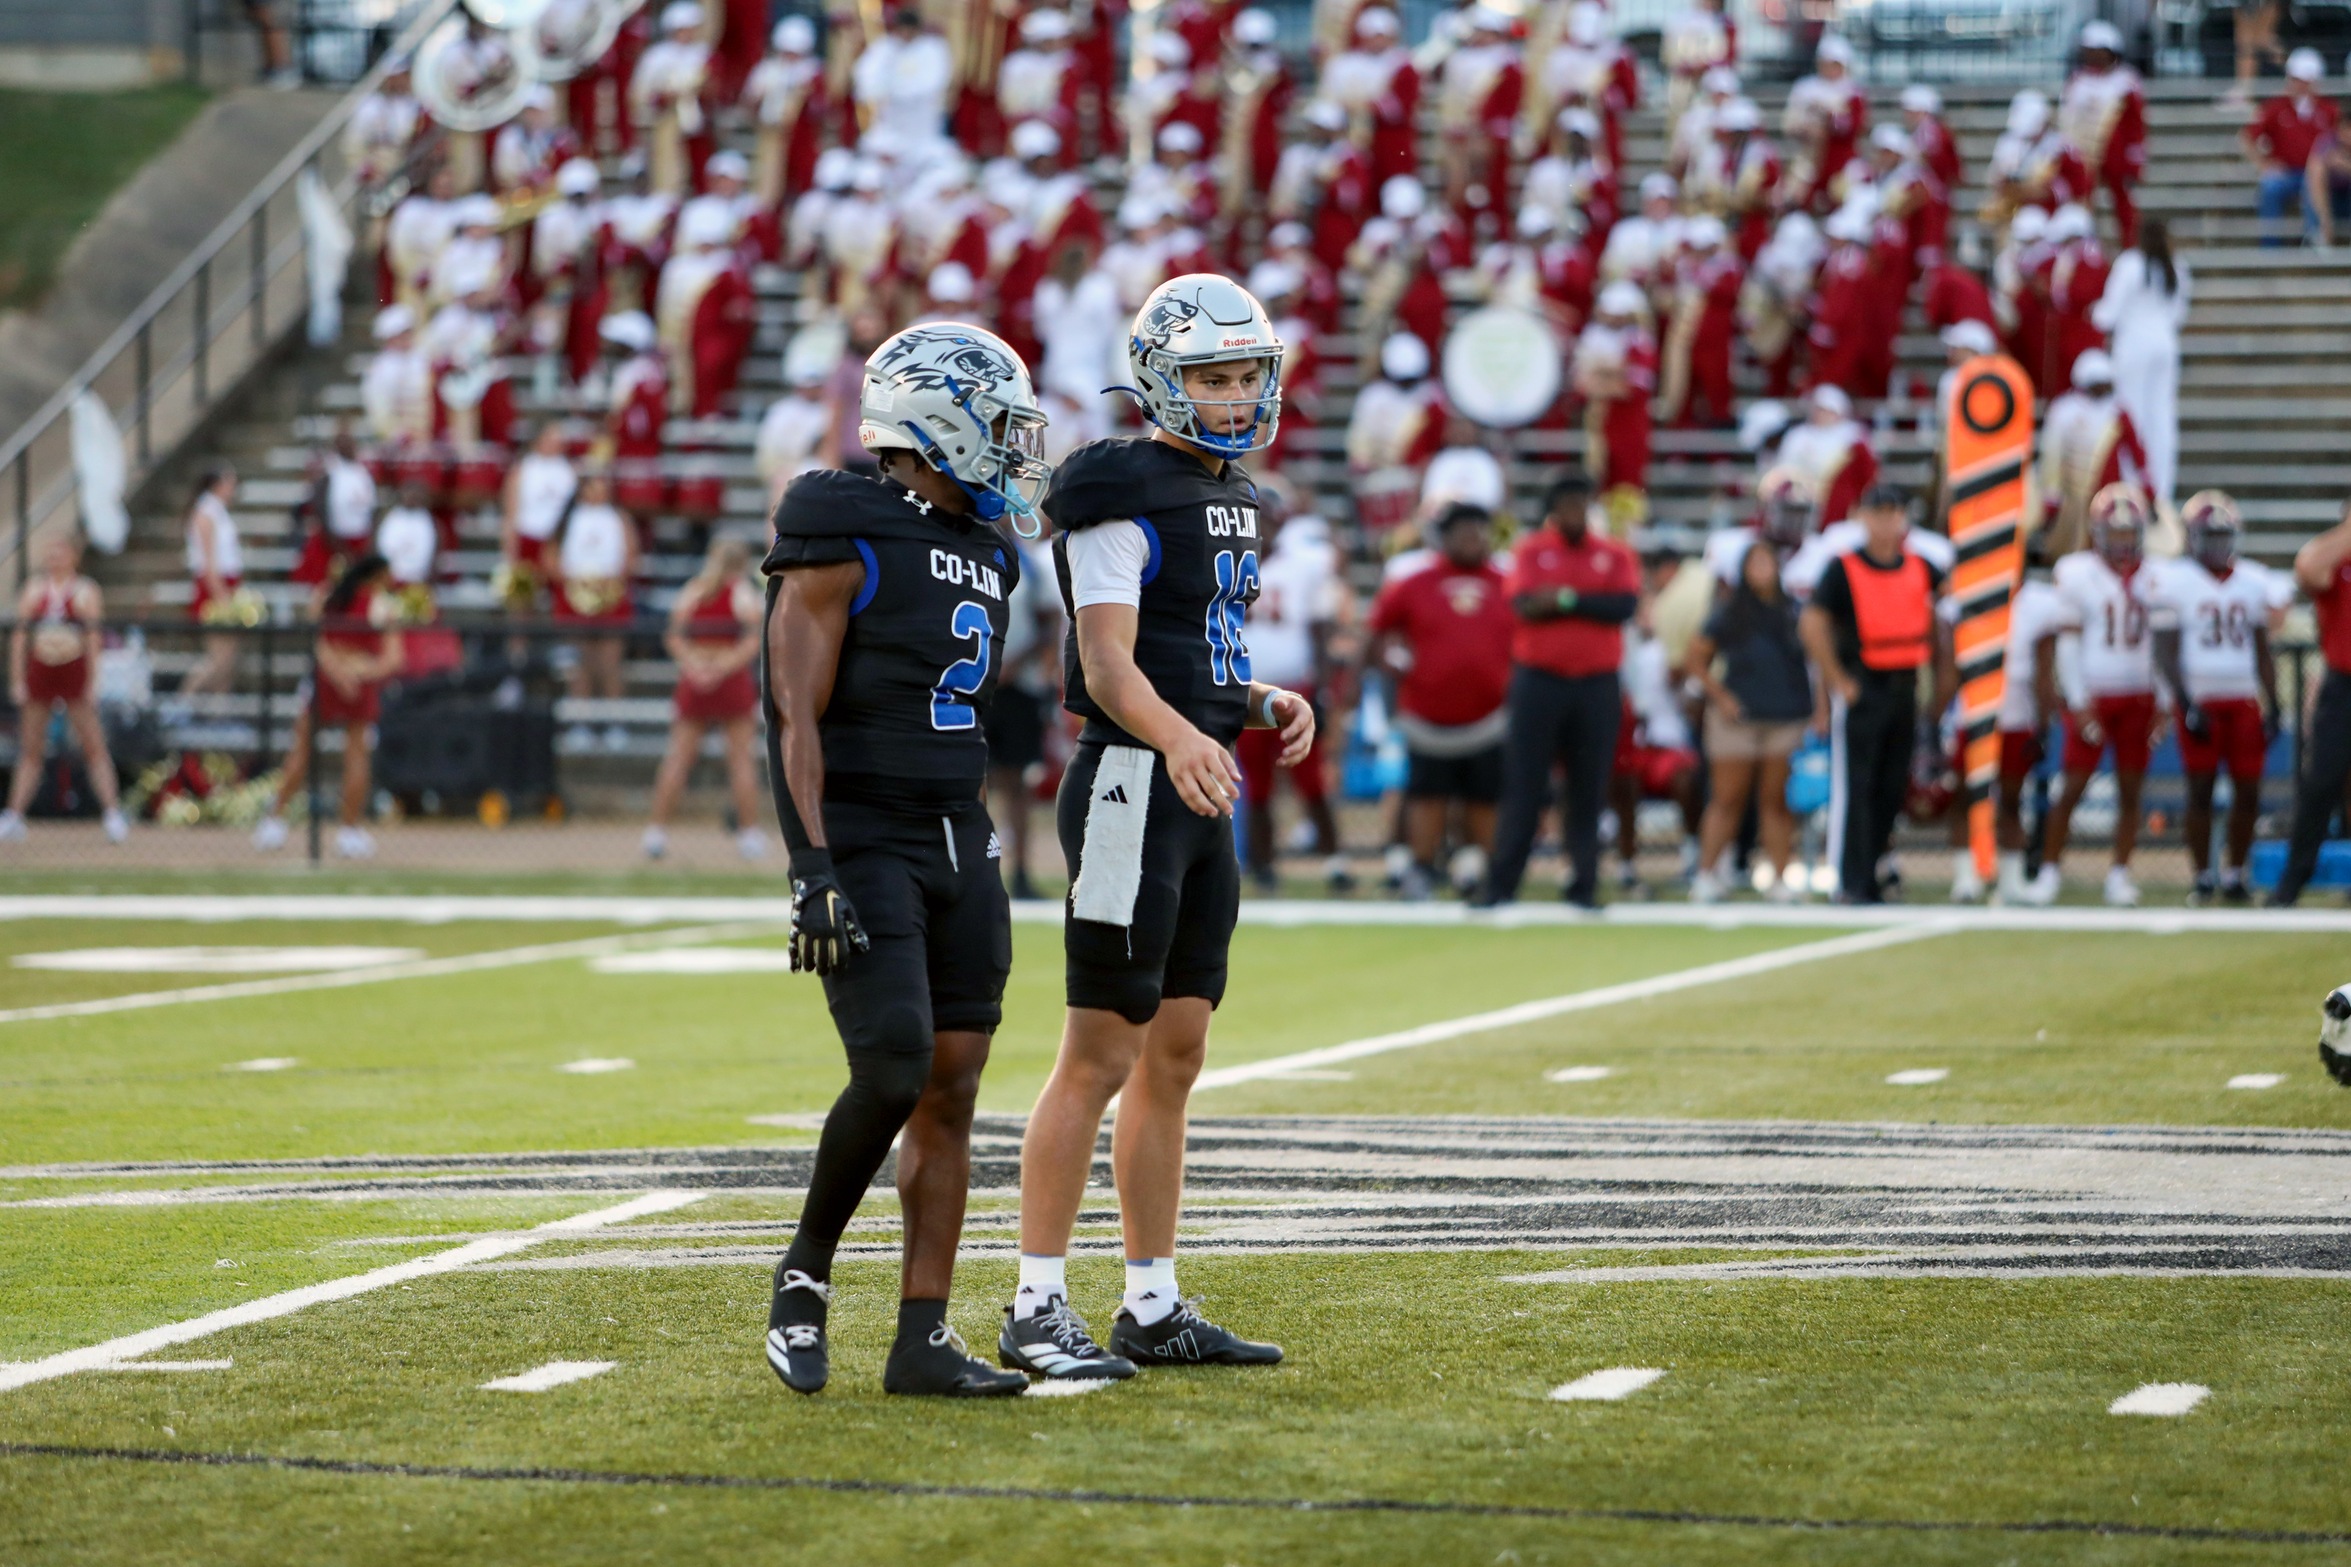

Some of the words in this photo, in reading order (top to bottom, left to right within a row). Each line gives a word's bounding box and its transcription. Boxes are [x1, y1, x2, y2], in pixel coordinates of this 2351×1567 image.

[1223, 338, 1257, 348] Riddell
[1206, 506, 1257, 539] CO-LIN
[930, 548, 1002, 601] CO-LIN
[1206, 550, 1260, 687] 16
[930, 600, 994, 731] 2
